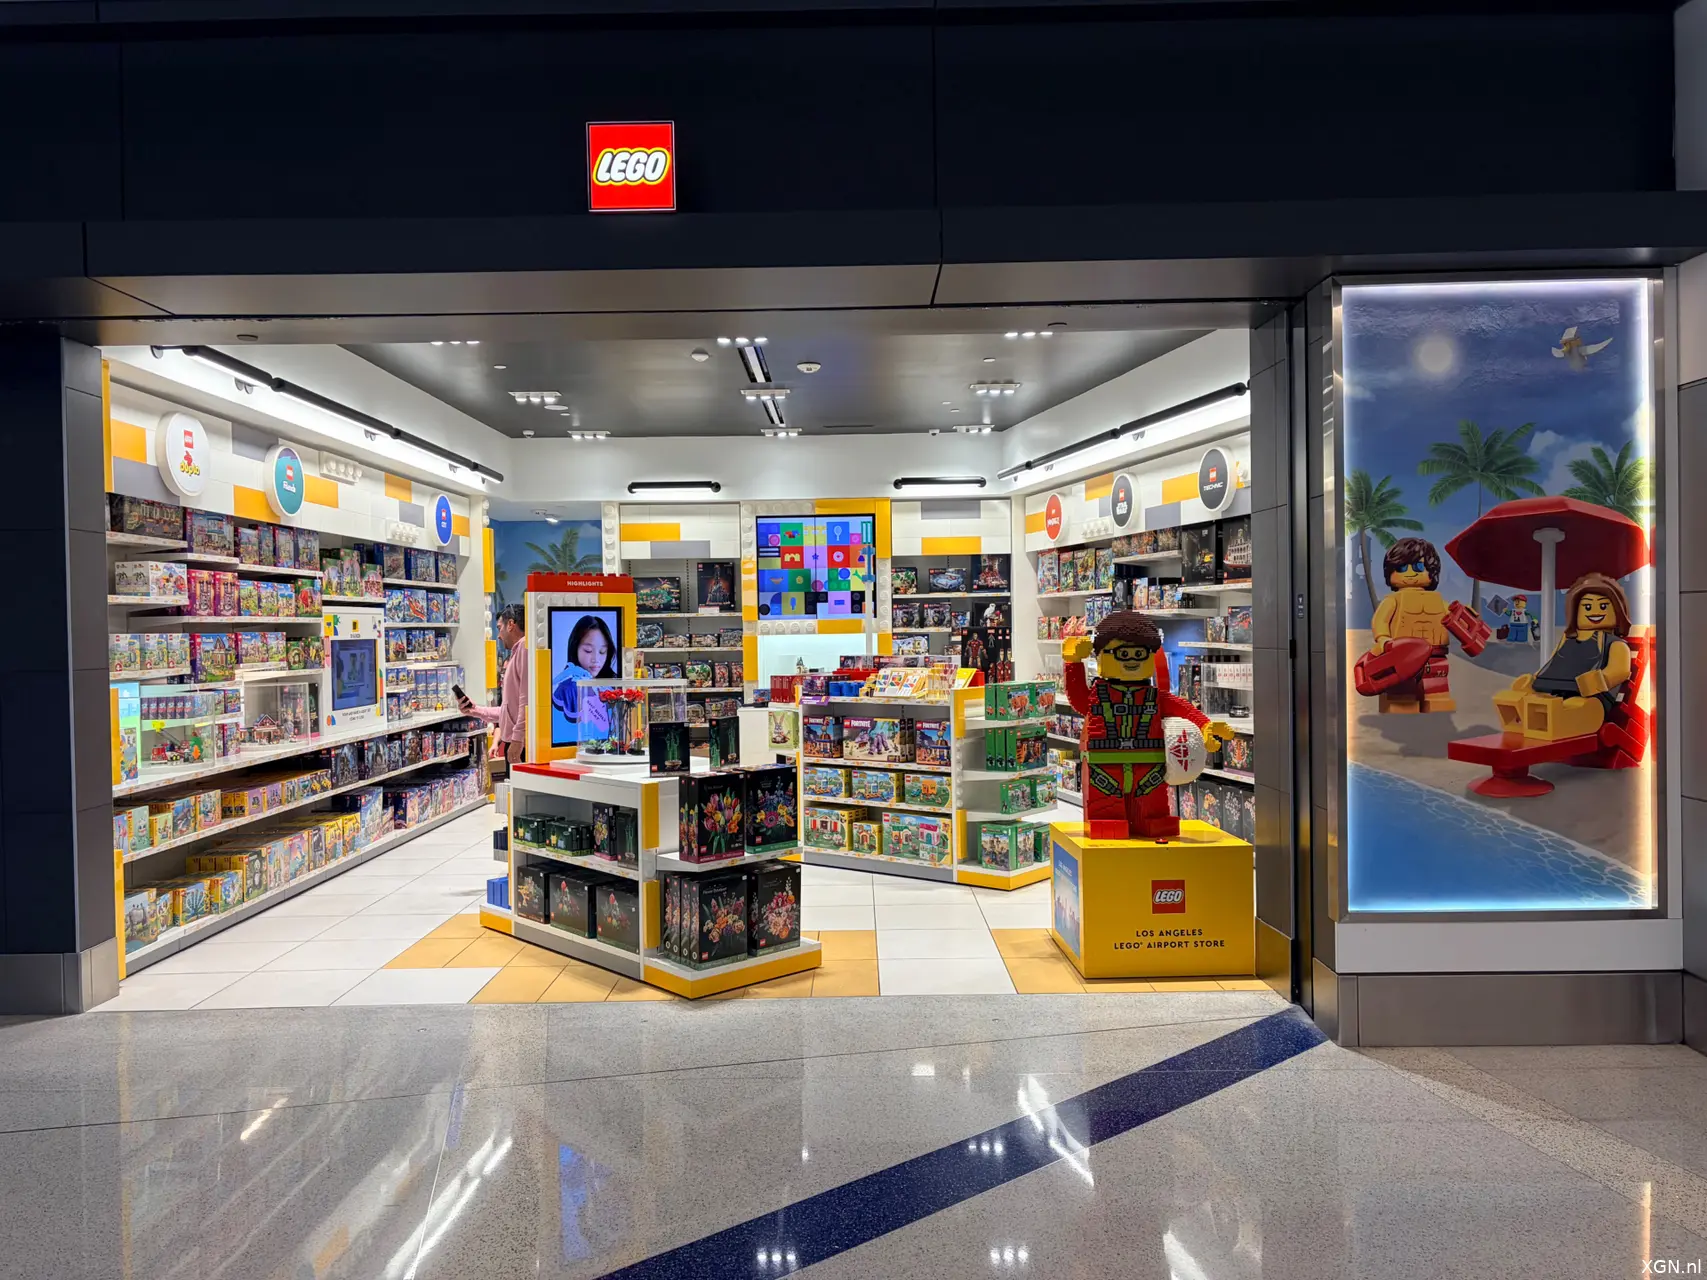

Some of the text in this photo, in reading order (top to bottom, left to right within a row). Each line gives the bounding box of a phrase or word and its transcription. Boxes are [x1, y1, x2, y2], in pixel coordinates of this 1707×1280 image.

[594, 148, 670, 185] LEGO
[1154, 889, 1183, 904] LEGO
[1136, 928, 1203, 938] LOS ANGELES
[1146, 940, 1190, 949] AIRPORT
[1194, 939, 1225, 948] STORE
